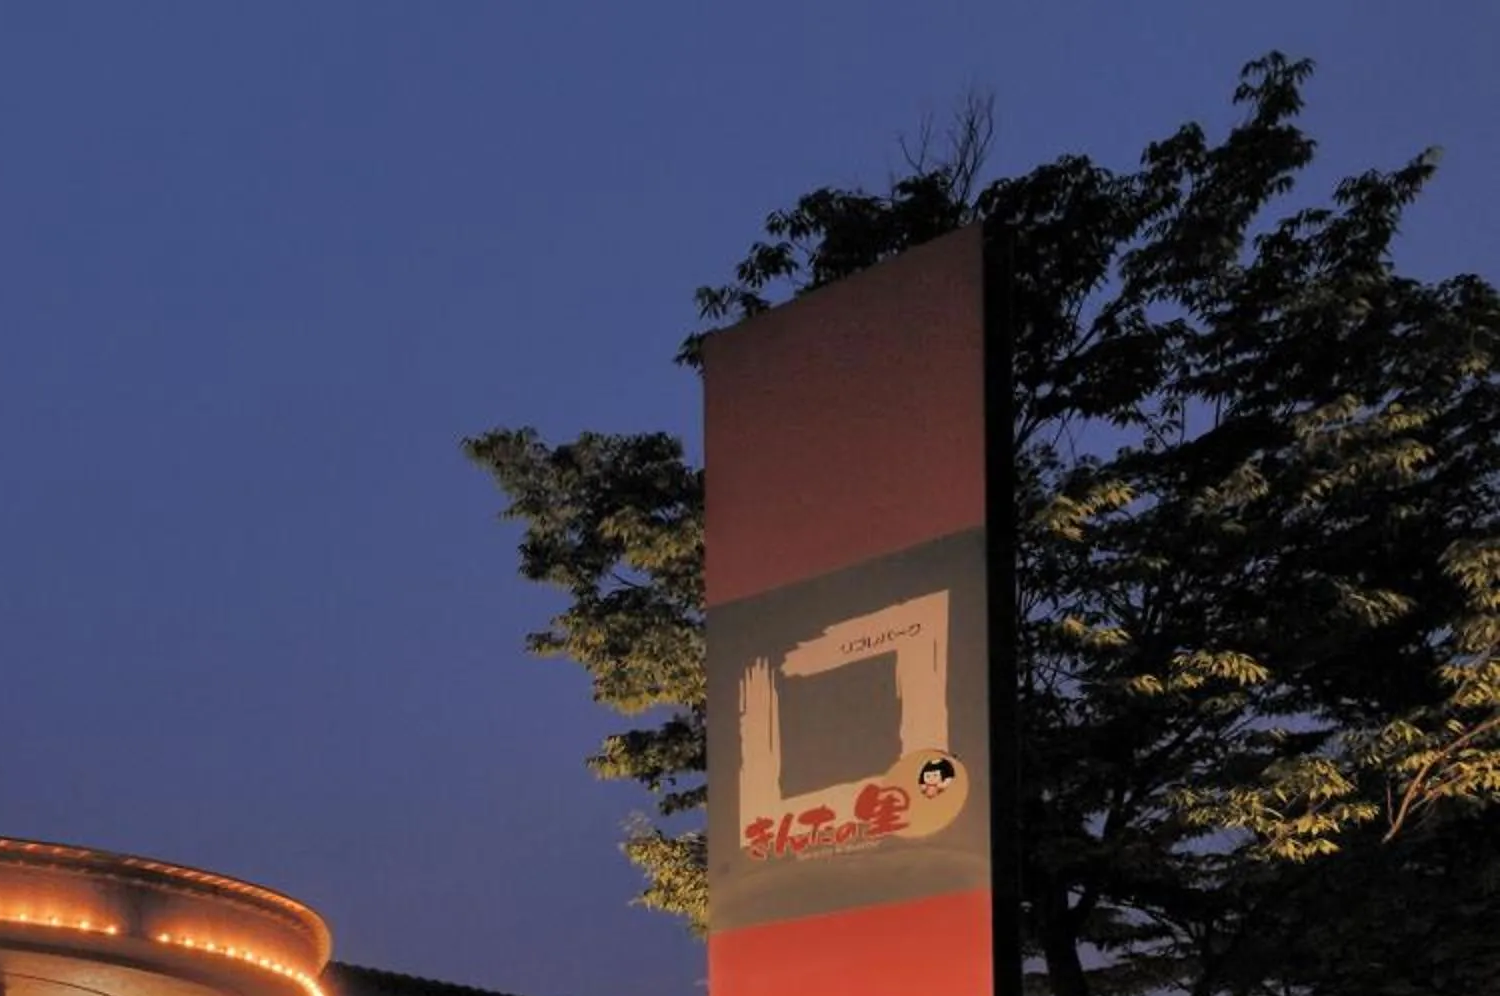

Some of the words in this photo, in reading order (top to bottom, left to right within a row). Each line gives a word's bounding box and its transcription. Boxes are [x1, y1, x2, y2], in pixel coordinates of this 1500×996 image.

[744, 783, 911, 860] きんたの里
